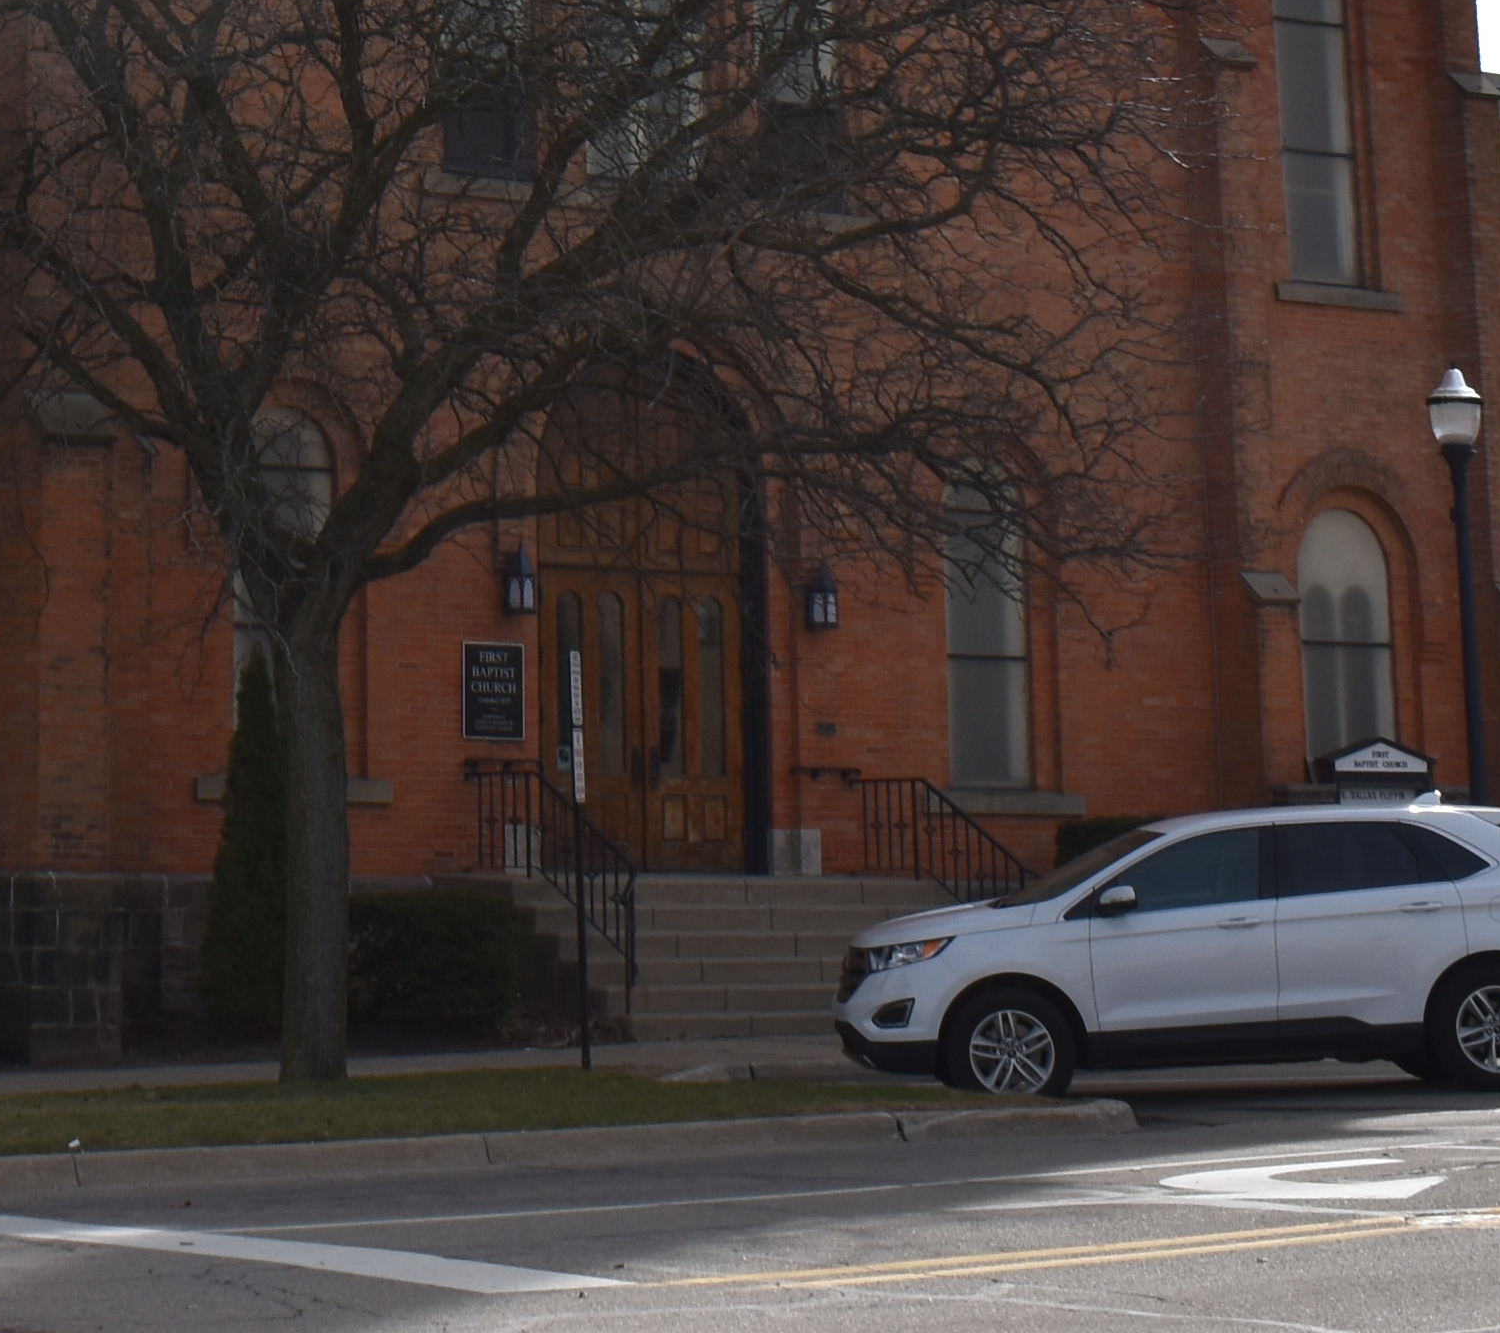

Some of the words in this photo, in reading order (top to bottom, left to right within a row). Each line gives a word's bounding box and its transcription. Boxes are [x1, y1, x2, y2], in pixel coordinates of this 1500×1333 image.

[478, 651, 508, 663] FIRST
[472, 665, 516, 679] BAPTIST
[470, 681, 517, 694] CHURCH
[1372, 751, 1389, 759] FIRST
[1354, 760, 1378, 768] BAPTIST
